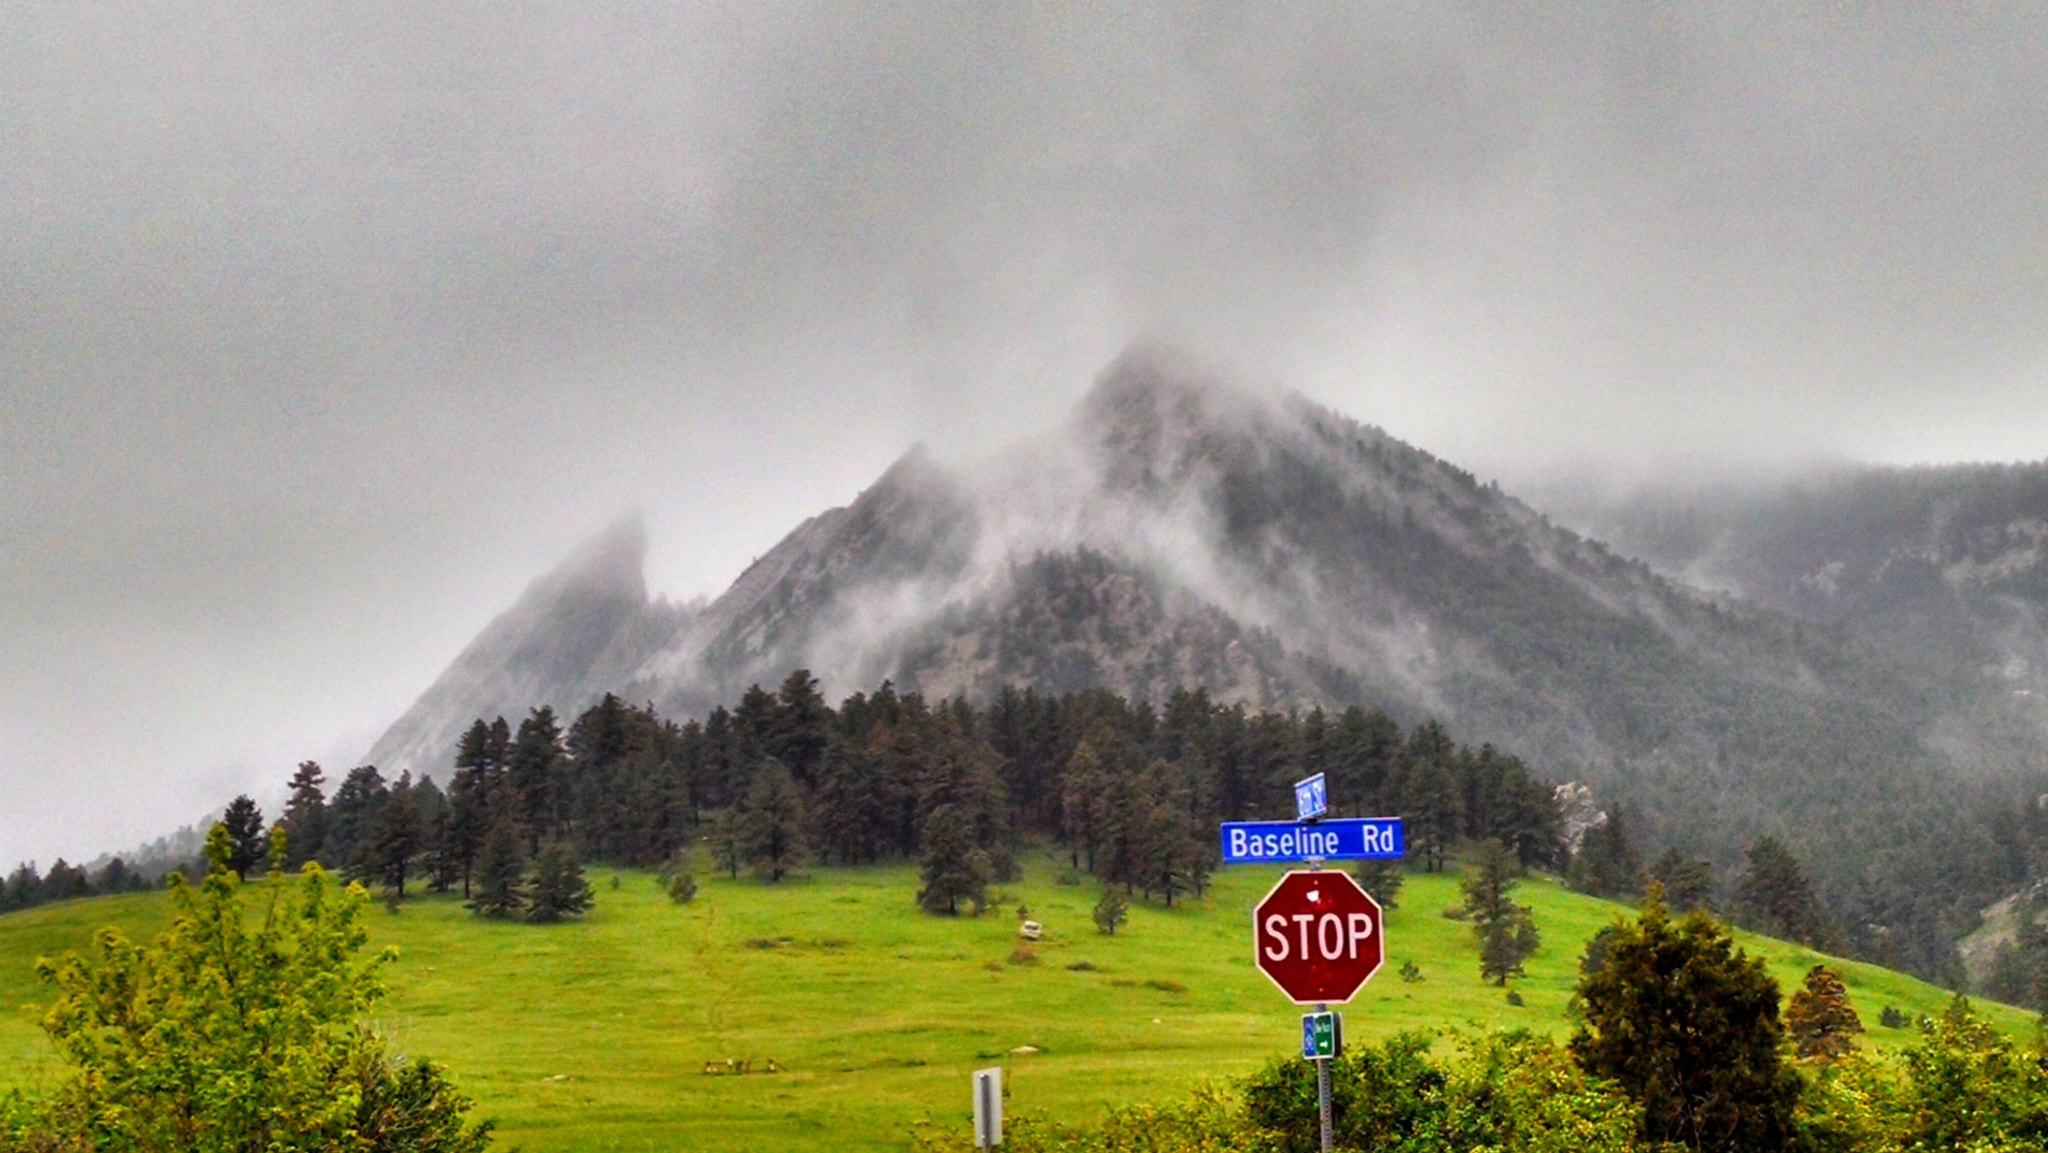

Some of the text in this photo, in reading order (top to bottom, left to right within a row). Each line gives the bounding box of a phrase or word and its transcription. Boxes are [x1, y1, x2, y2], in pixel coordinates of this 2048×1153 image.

[1230, 824, 1394, 857] Baseline Rd
[1265, 913, 1373, 962] STOP
